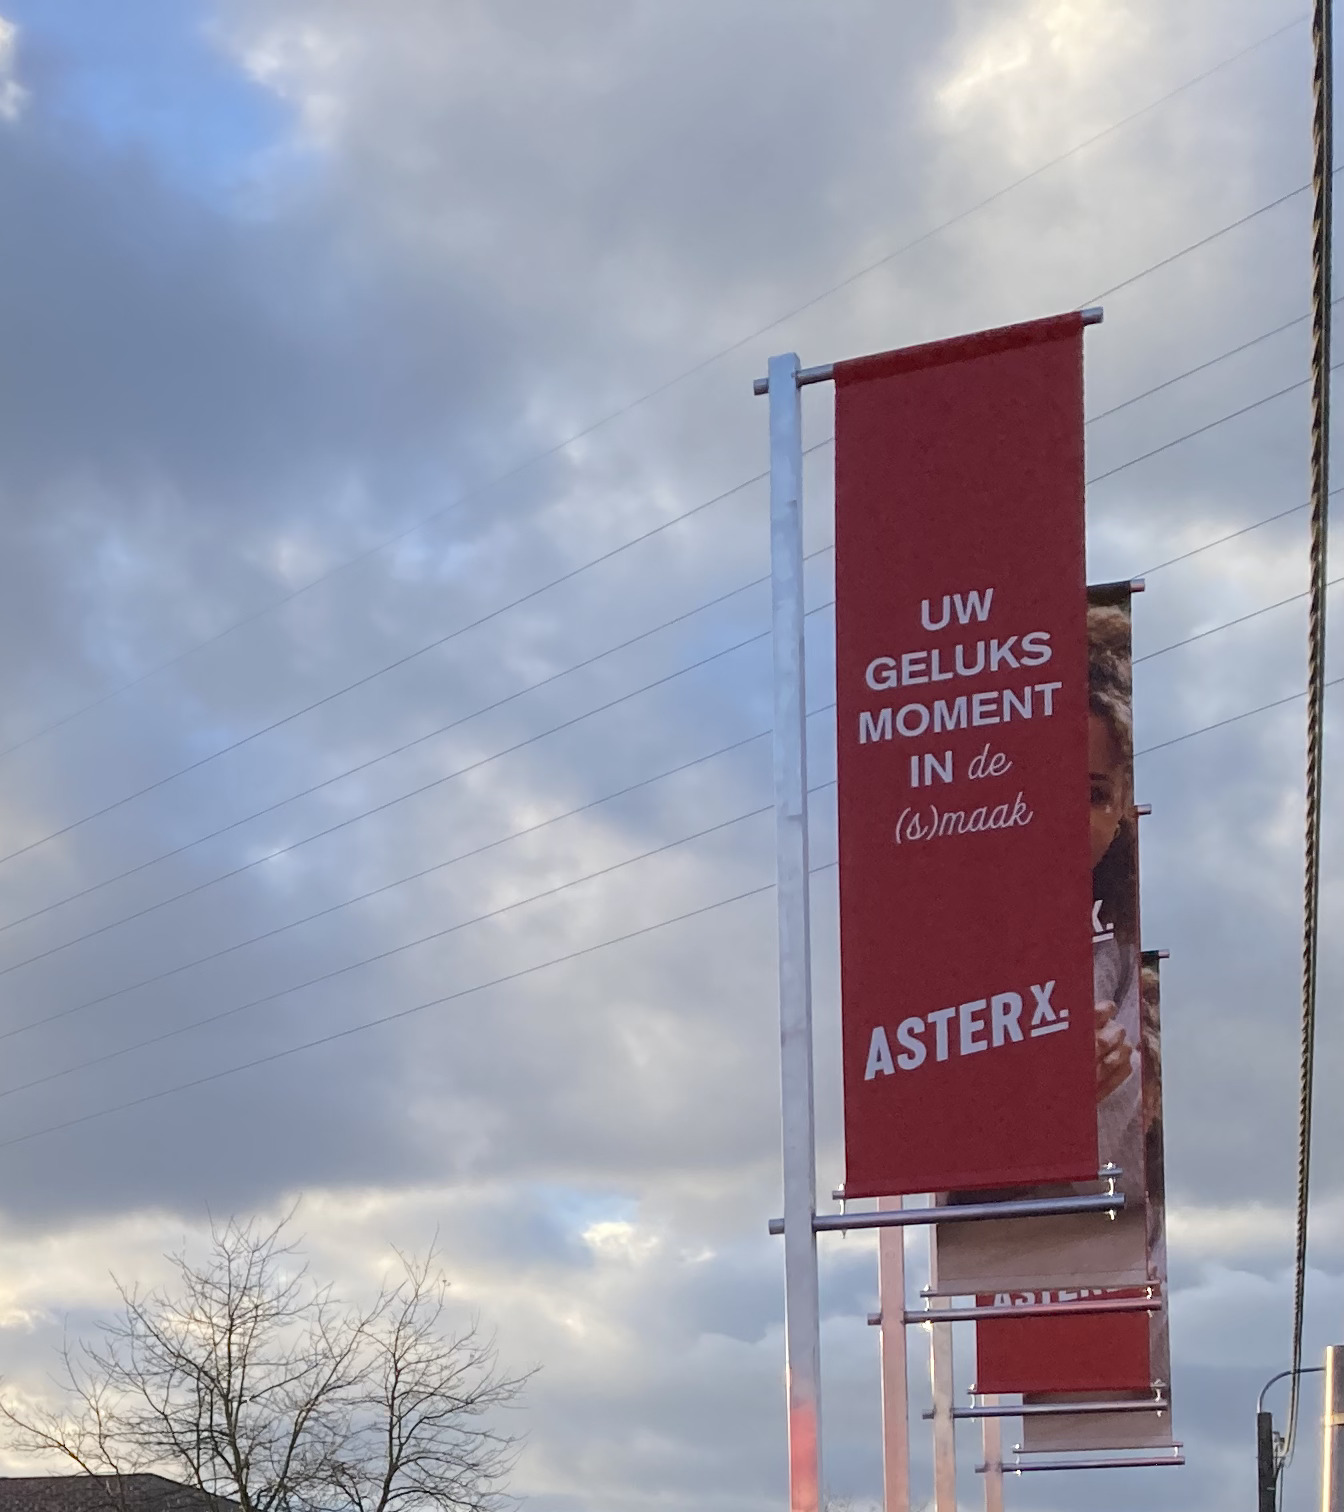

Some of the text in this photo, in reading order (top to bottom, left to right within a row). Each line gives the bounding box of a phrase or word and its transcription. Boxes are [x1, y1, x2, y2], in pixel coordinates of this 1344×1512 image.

[920, 588, 994, 631] UW
[865, 631, 1053, 691] GELUKS
[859, 681, 1063, 744] MOMENT
[910, 743, 1013, 788] IN de
[895, 792, 1035, 844] (s)maak
